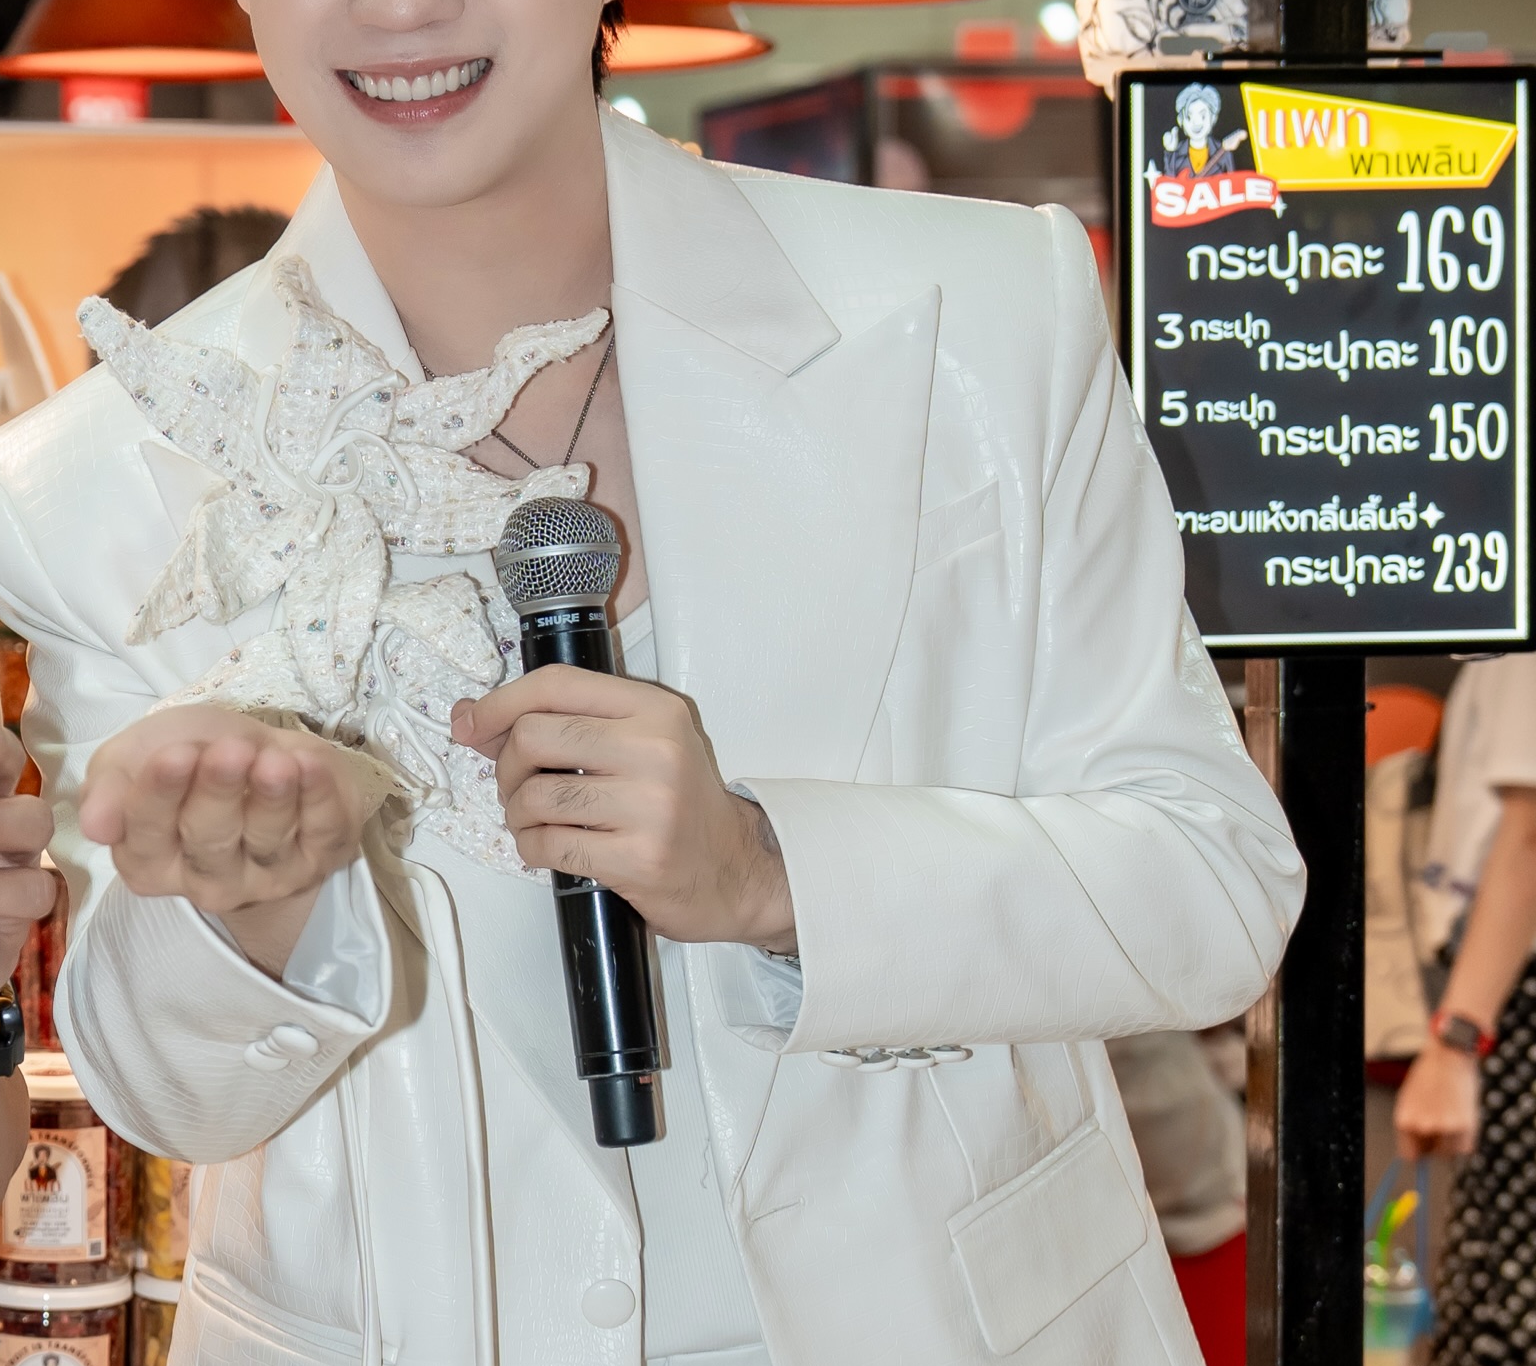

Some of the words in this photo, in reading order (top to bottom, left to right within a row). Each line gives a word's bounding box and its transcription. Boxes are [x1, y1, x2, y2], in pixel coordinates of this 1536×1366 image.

[1257, 106, 1371, 150] แพท
[1349, 146, 1477, 177] พาเพลิน
[1155, 178, 1274, 217] SALE
[1187, 231, 1385, 294] กระปุกละ
[1397, 204, 1505, 293] 169
[1154, 313, 1184, 350] 3
[1190, 311, 1271, 349] กระปุก
[1258, 329, 1419, 382] กระปุกละ
[1428, 315, 1509, 377] 160
[1159, 390, 1189, 427] 5
[1195, 392, 1277, 430] กระปุก
[1259, 414, 1421, 467] กระปุกละ
[1428, 401, 1510, 462] 150
[1264, 544, 1426, 598] กระปุกละ
[1432, 530, 1510, 594] 239
[537, 613, 580, 628] SHURE
